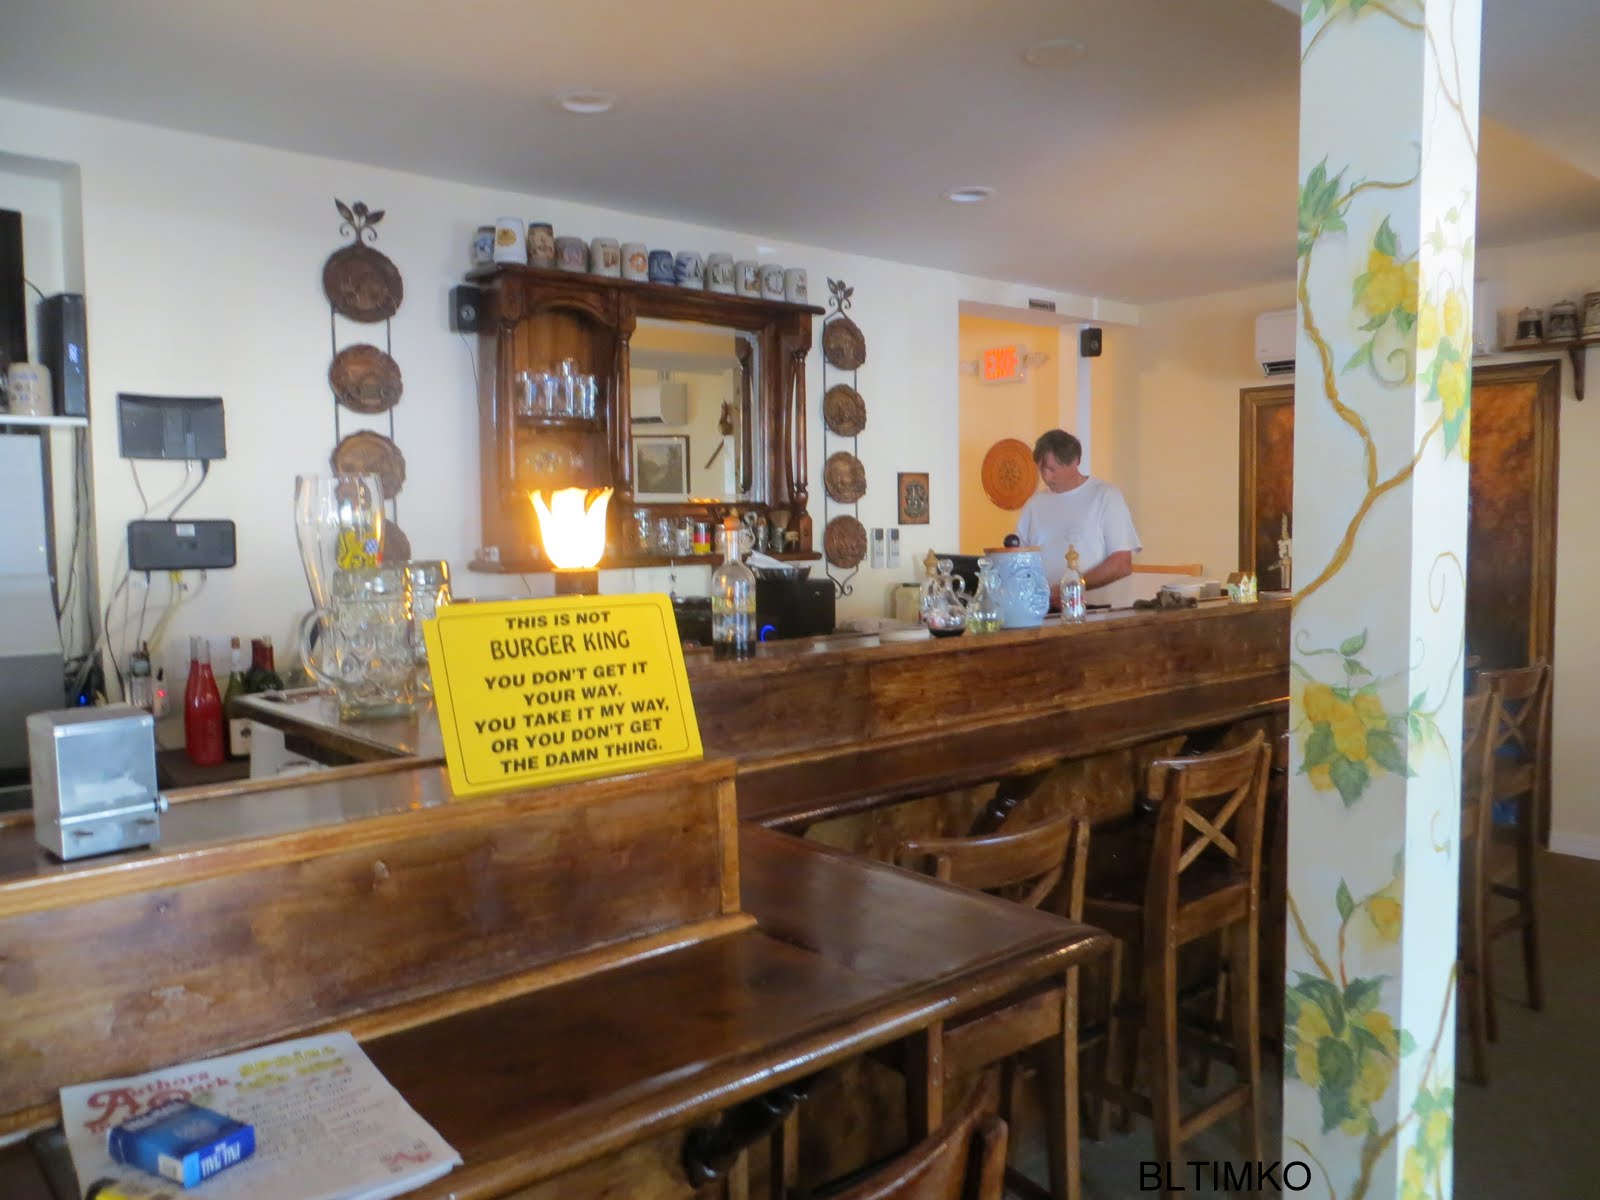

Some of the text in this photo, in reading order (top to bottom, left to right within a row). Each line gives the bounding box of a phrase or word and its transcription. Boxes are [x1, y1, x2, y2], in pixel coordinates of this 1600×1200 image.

[505, 611, 610, 630] THIS IS NOT
[490, 629, 630, 660] BURGER KING
[484, 661, 648, 690] YOU DON'T GET IT
[523, 683, 622, 707] YOUR WAY.
[474, 716, 516, 735] YOU
[522, 709, 572, 728] TAKE
[577, 706, 595, 721] IT
[600, 703, 625, 717] MY
[491, 717, 663, 754] OR YOU DON'T GET
[500, 738, 662, 774] THE DAMN THING.
